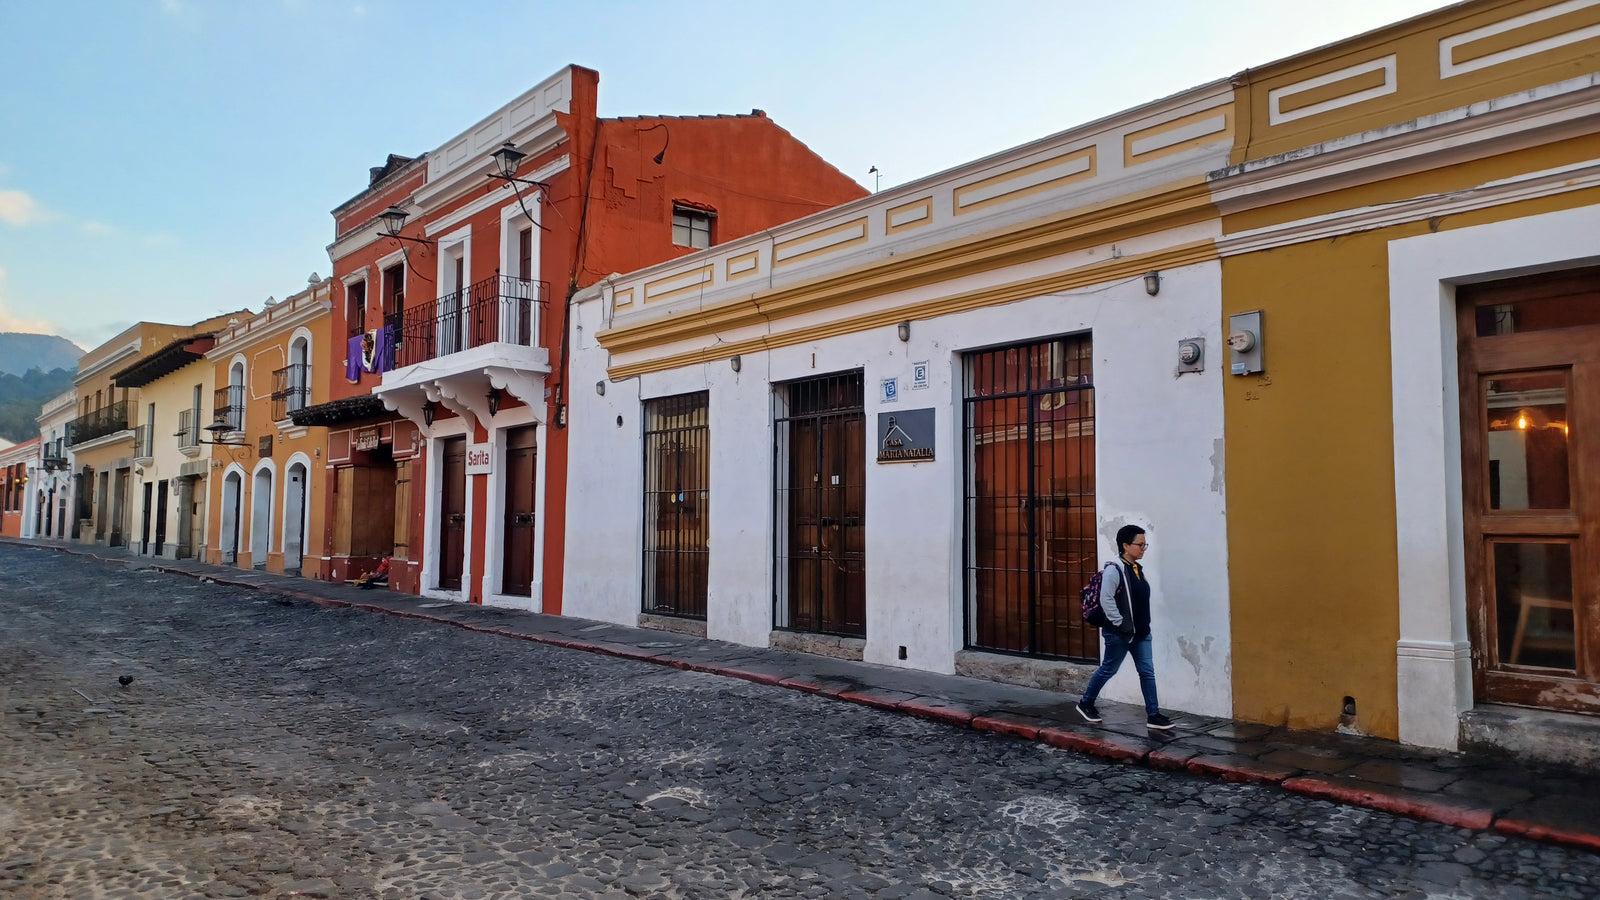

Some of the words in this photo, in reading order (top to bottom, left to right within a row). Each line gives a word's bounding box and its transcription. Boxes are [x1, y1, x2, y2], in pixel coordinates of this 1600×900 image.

[468, 450, 489, 466] Sarita
[879, 449, 903, 459] MARIA
[903, 447, 934, 457] NATALIA
